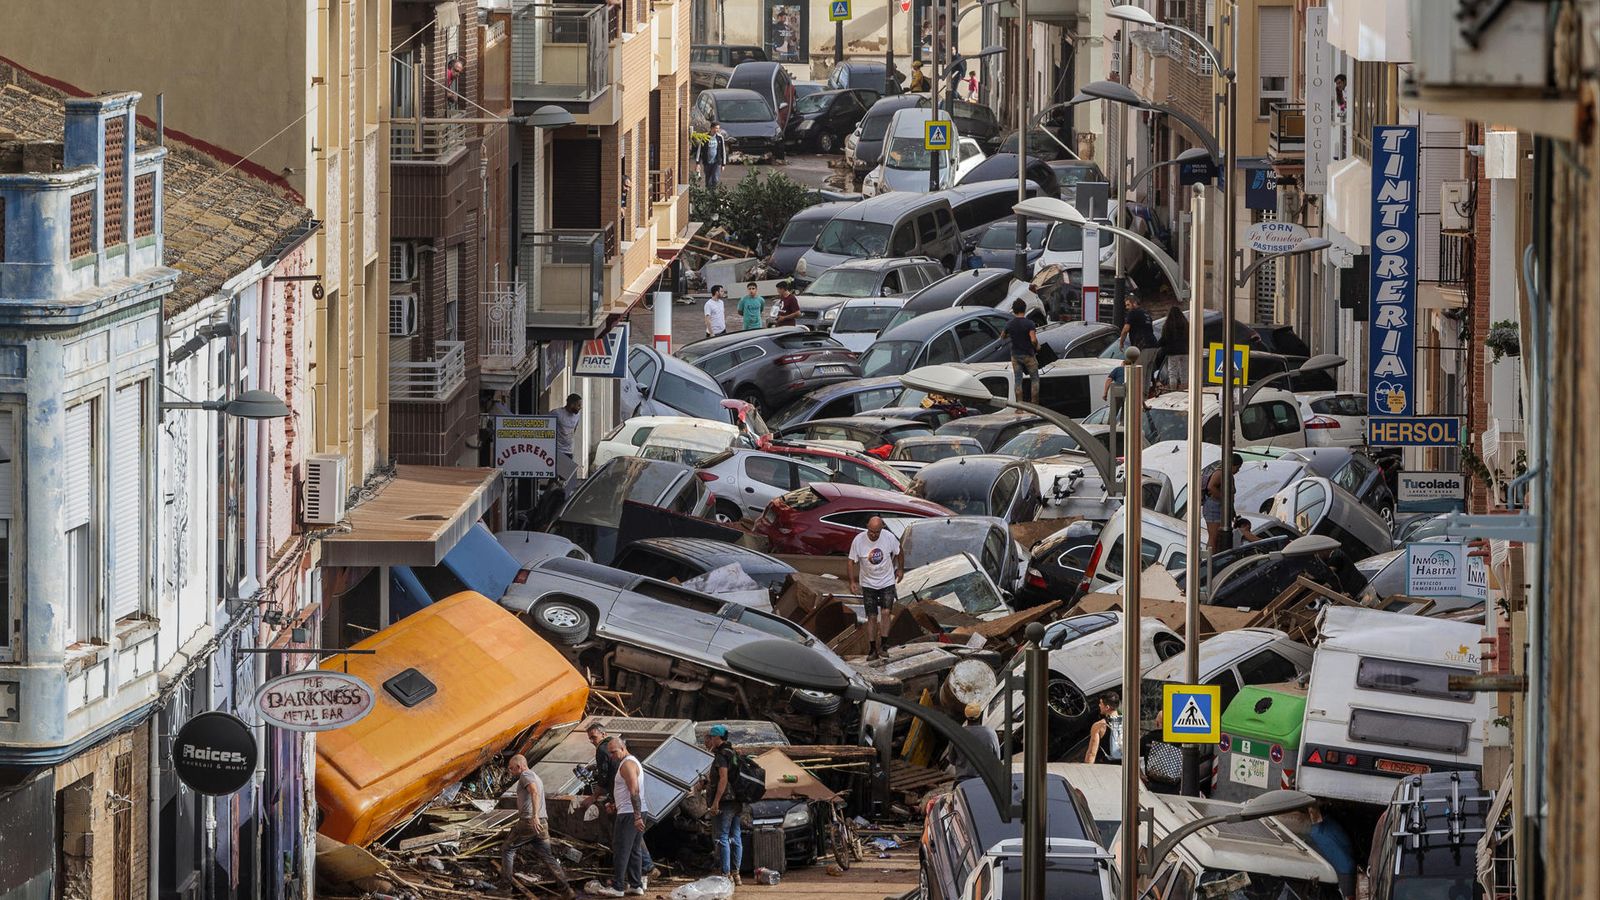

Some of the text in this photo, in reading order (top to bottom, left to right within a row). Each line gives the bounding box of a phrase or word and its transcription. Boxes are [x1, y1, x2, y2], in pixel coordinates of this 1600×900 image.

[1312, 15, 1324, 88] EMILIO
[1261, 223, 1293, 232] FORN
[1249, 231, 1261, 241] La
[1252, 241, 1298, 252] PASTISSERI
[1374, 129, 1411, 378] TINTORERIA
[582, 357, 611, 365] FIATC
[1371, 422, 1457, 443] HERSOL
[496, 443, 555, 467] GUERRERO
[1402, 478, 1460, 489] Tucolada
[1412, 554, 1438, 565] INMO
[302, 677, 324, 688] PUB
[267, 687, 362, 708] DARKNESS
[283, 709, 318, 721] METAL
[321, 708, 344, 720] BAR
[182, 760, 213, 769] cocktail
